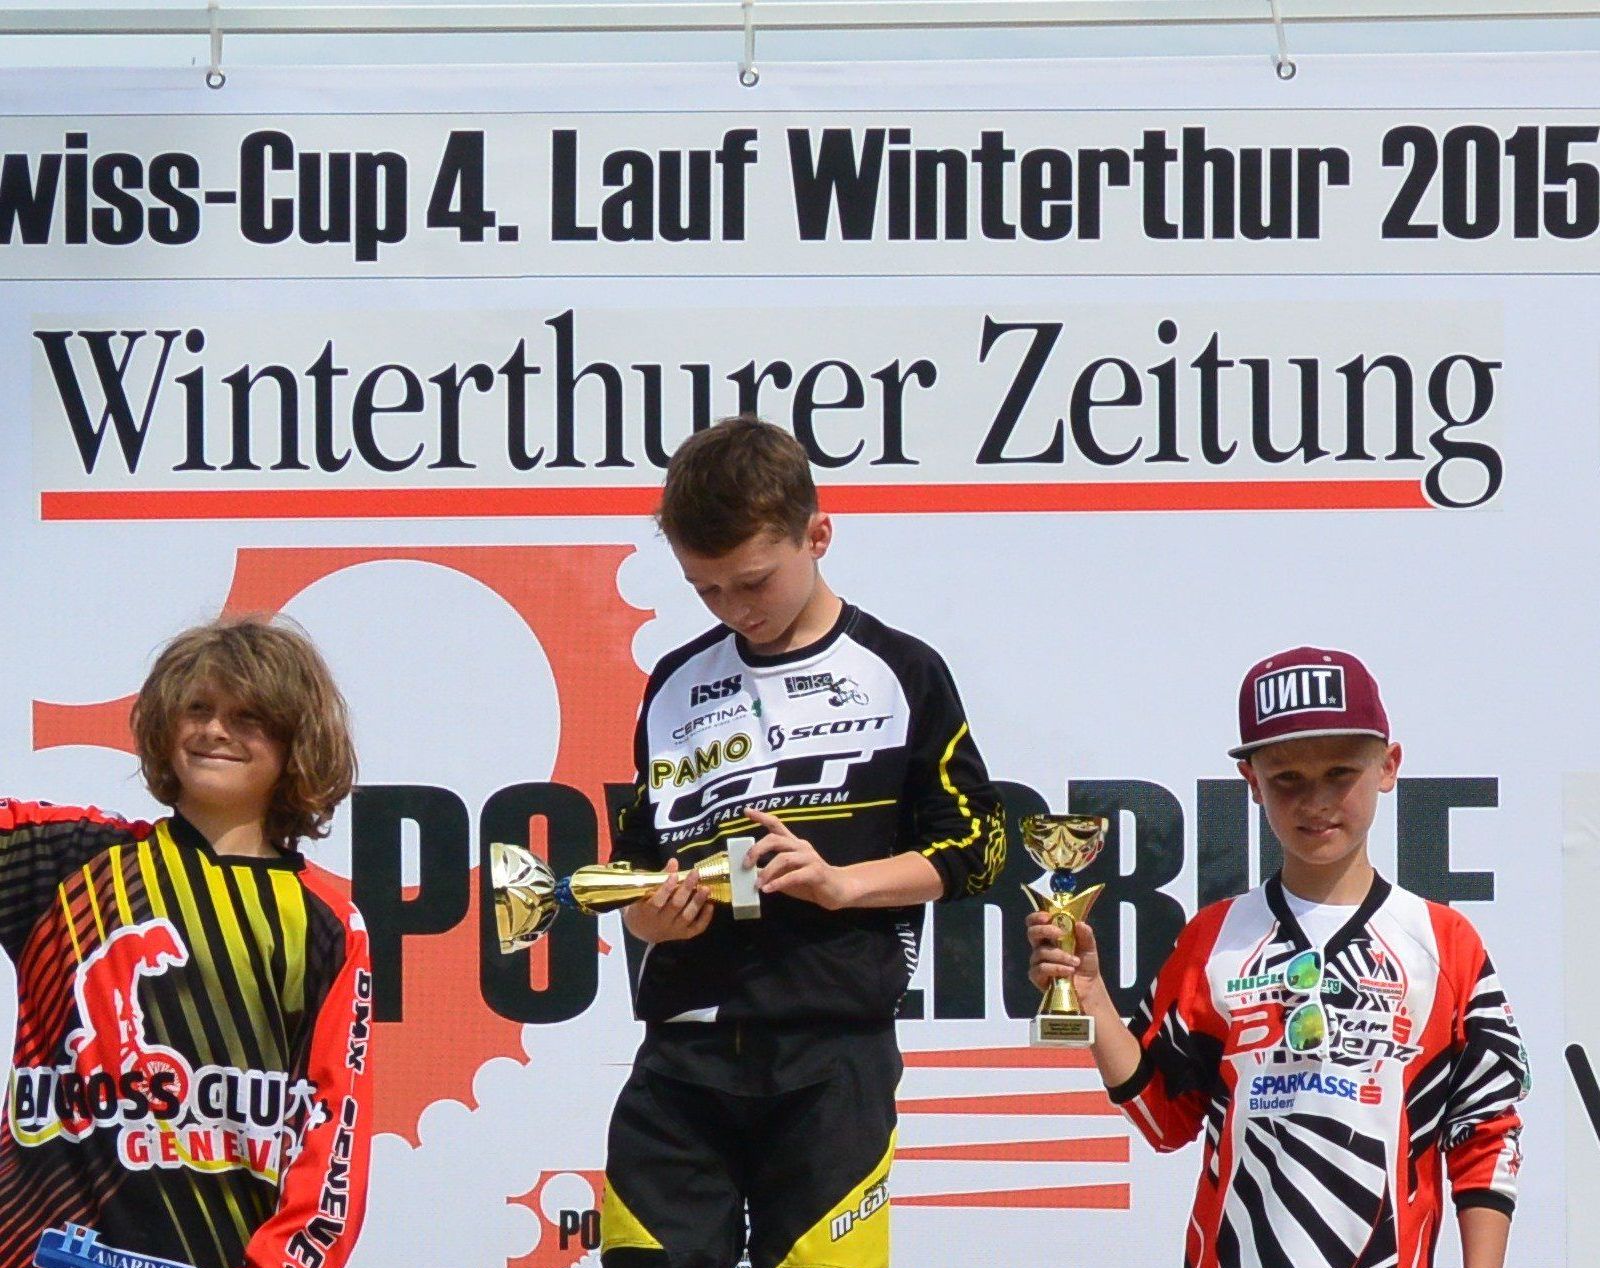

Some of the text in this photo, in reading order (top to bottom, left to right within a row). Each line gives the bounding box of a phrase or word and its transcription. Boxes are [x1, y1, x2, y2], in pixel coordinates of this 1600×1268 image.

[427, 130, 520, 243] 4.
[551, 129, 758, 242] Lauf
[787, 126, 1351, 241] Winterthur
[33, 308, 1503, 508] Winterthurer Zeitung
[1258, 669, 1336, 715] UNIT
[672, 704, 748, 740] CERTINA
[791, 715, 894, 741] SCOTT
[651, 732, 752, 789] PAMO
[659, 819, 712, 845] SWISS
[799, 791, 850, 804] TEAM
[1250, 1071, 1358, 1101] SPARKASSE
